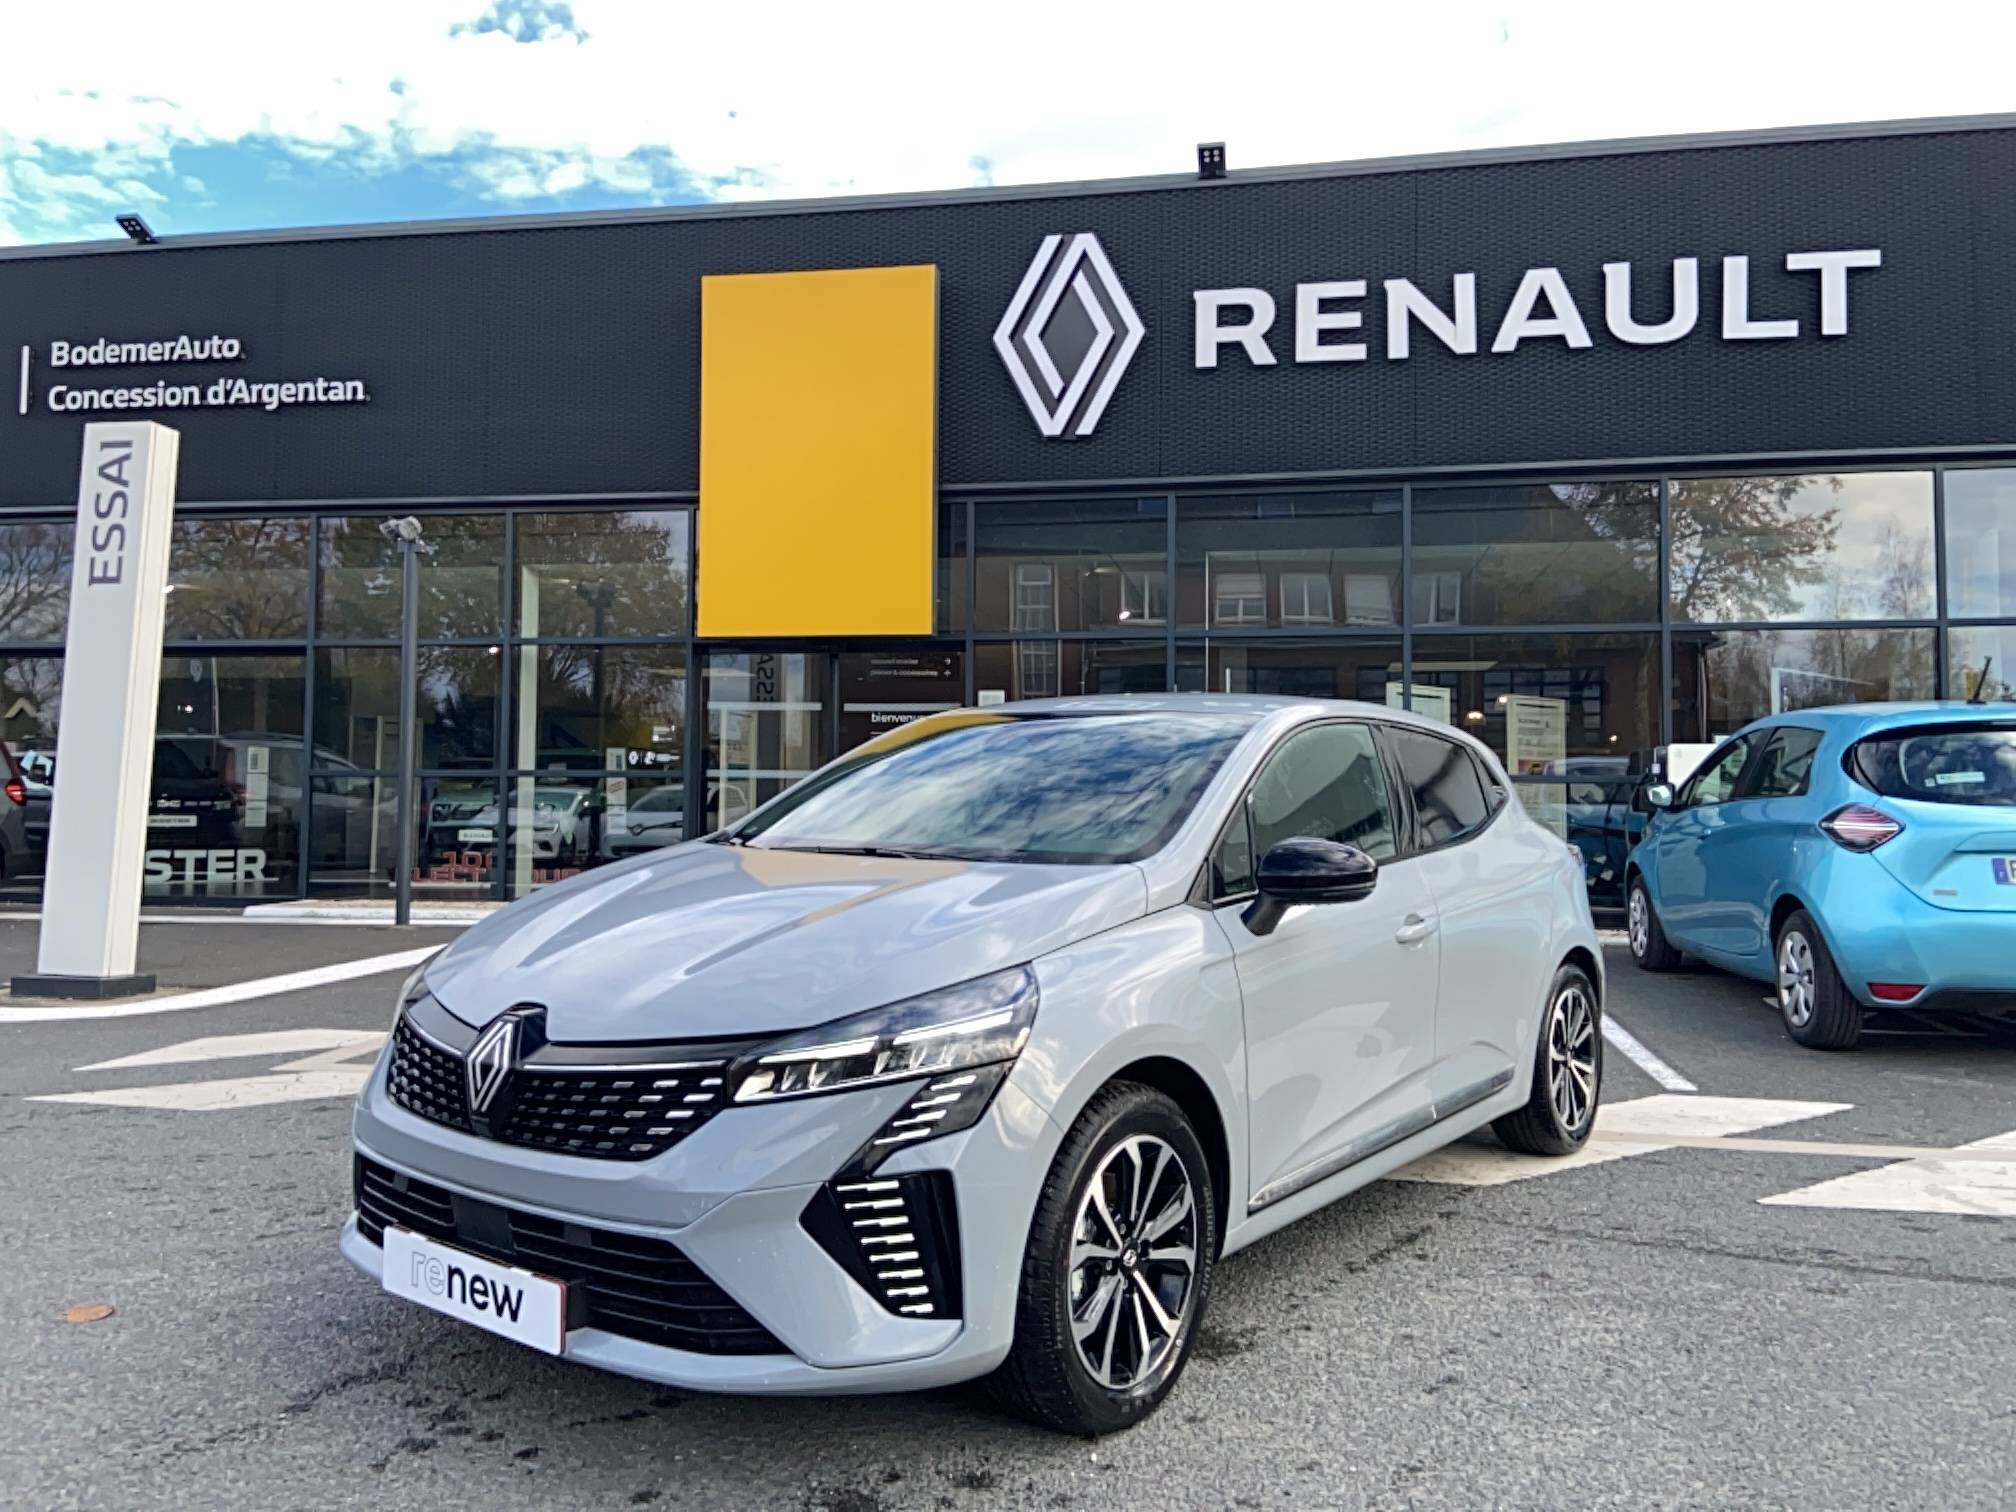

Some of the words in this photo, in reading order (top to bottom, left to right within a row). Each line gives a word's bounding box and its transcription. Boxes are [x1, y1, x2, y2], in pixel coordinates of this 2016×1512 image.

[1193, 248, 1883, 370] RENAULT
[50, 334, 241, 368] BodemerAuto
[48, 380, 201, 411] Concession
[207, 377, 366, 411] d'Argentan
[88, 440, 133, 587] ESSAI
[871, 712, 929, 723] bienvenu
[145, 848, 267, 883] STER
[410, 1251, 524, 1323] renew
